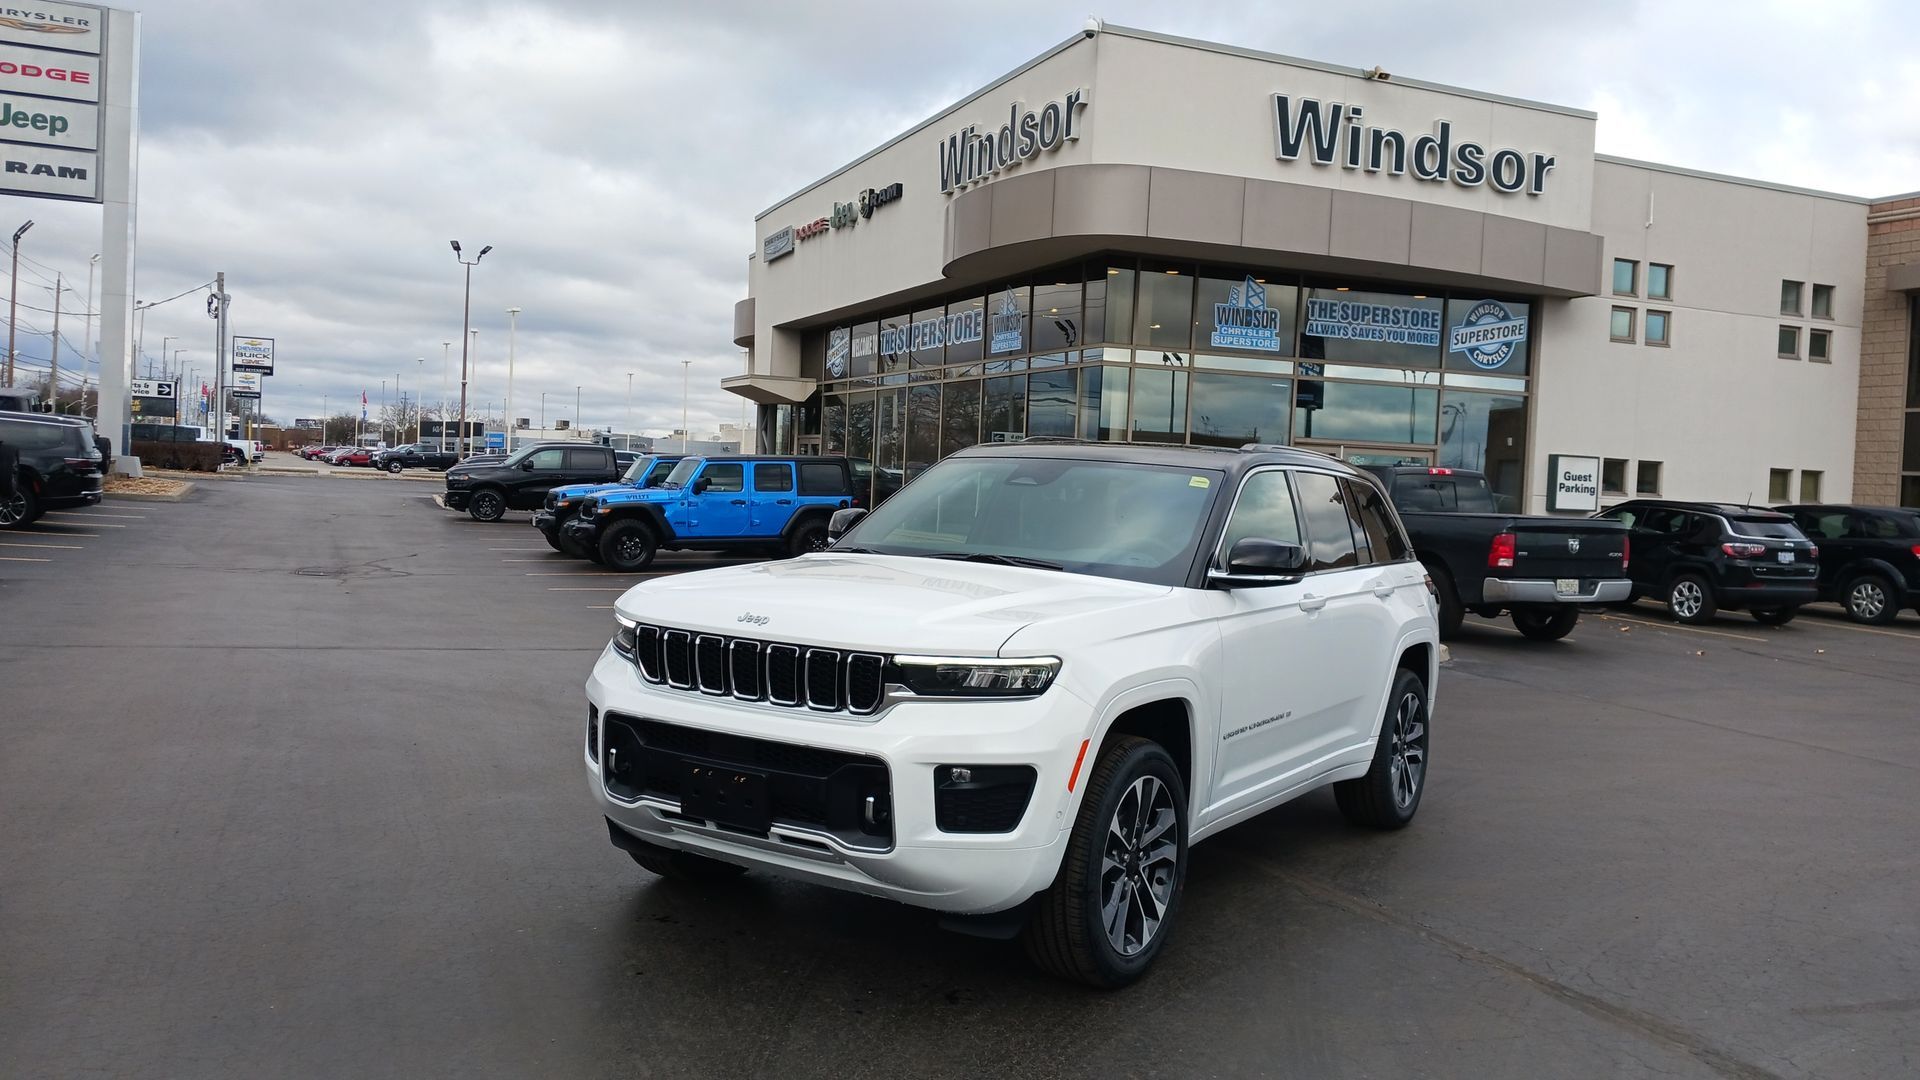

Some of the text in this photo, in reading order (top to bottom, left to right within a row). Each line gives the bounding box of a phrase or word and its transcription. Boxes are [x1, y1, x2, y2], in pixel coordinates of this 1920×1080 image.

[0, 8, 89, 26] RYSLER
[0, 103, 68, 137] Jeep
[938, 87, 1089, 195] Windsor
[1270, 92, 1557, 196] Windsor
[5, 160, 87, 180] RAM
[869, 182, 903, 207] RAM
[795, 217, 829, 241] DODGE
[1216, 306, 1278, 329] WINDSOR
[1308, 300, 1439, 329] THE SUPERSTORE
[1469, 304, 1505, 322] WINDSOR
[881, 310, 983, 355] THE SUPERSTORE
[1214, 335, 1277, 348] SUPERSTORE
[1221, 327, 1271, 338] CHRYSLER
[1308, 322, 1438, 344] ALWAYS SAVES YOU MORE!
[1453, 323, 1524, 346] SUPERSTORE
[235, 351, 271, 359] BUICK
[1473, 345, 1509, 365] CHRYSLER
[1563, 471, 1592, 482] Guest
[1559, 482, 1596, 496] Parking
[737, 611, 770, 627] Jeep
